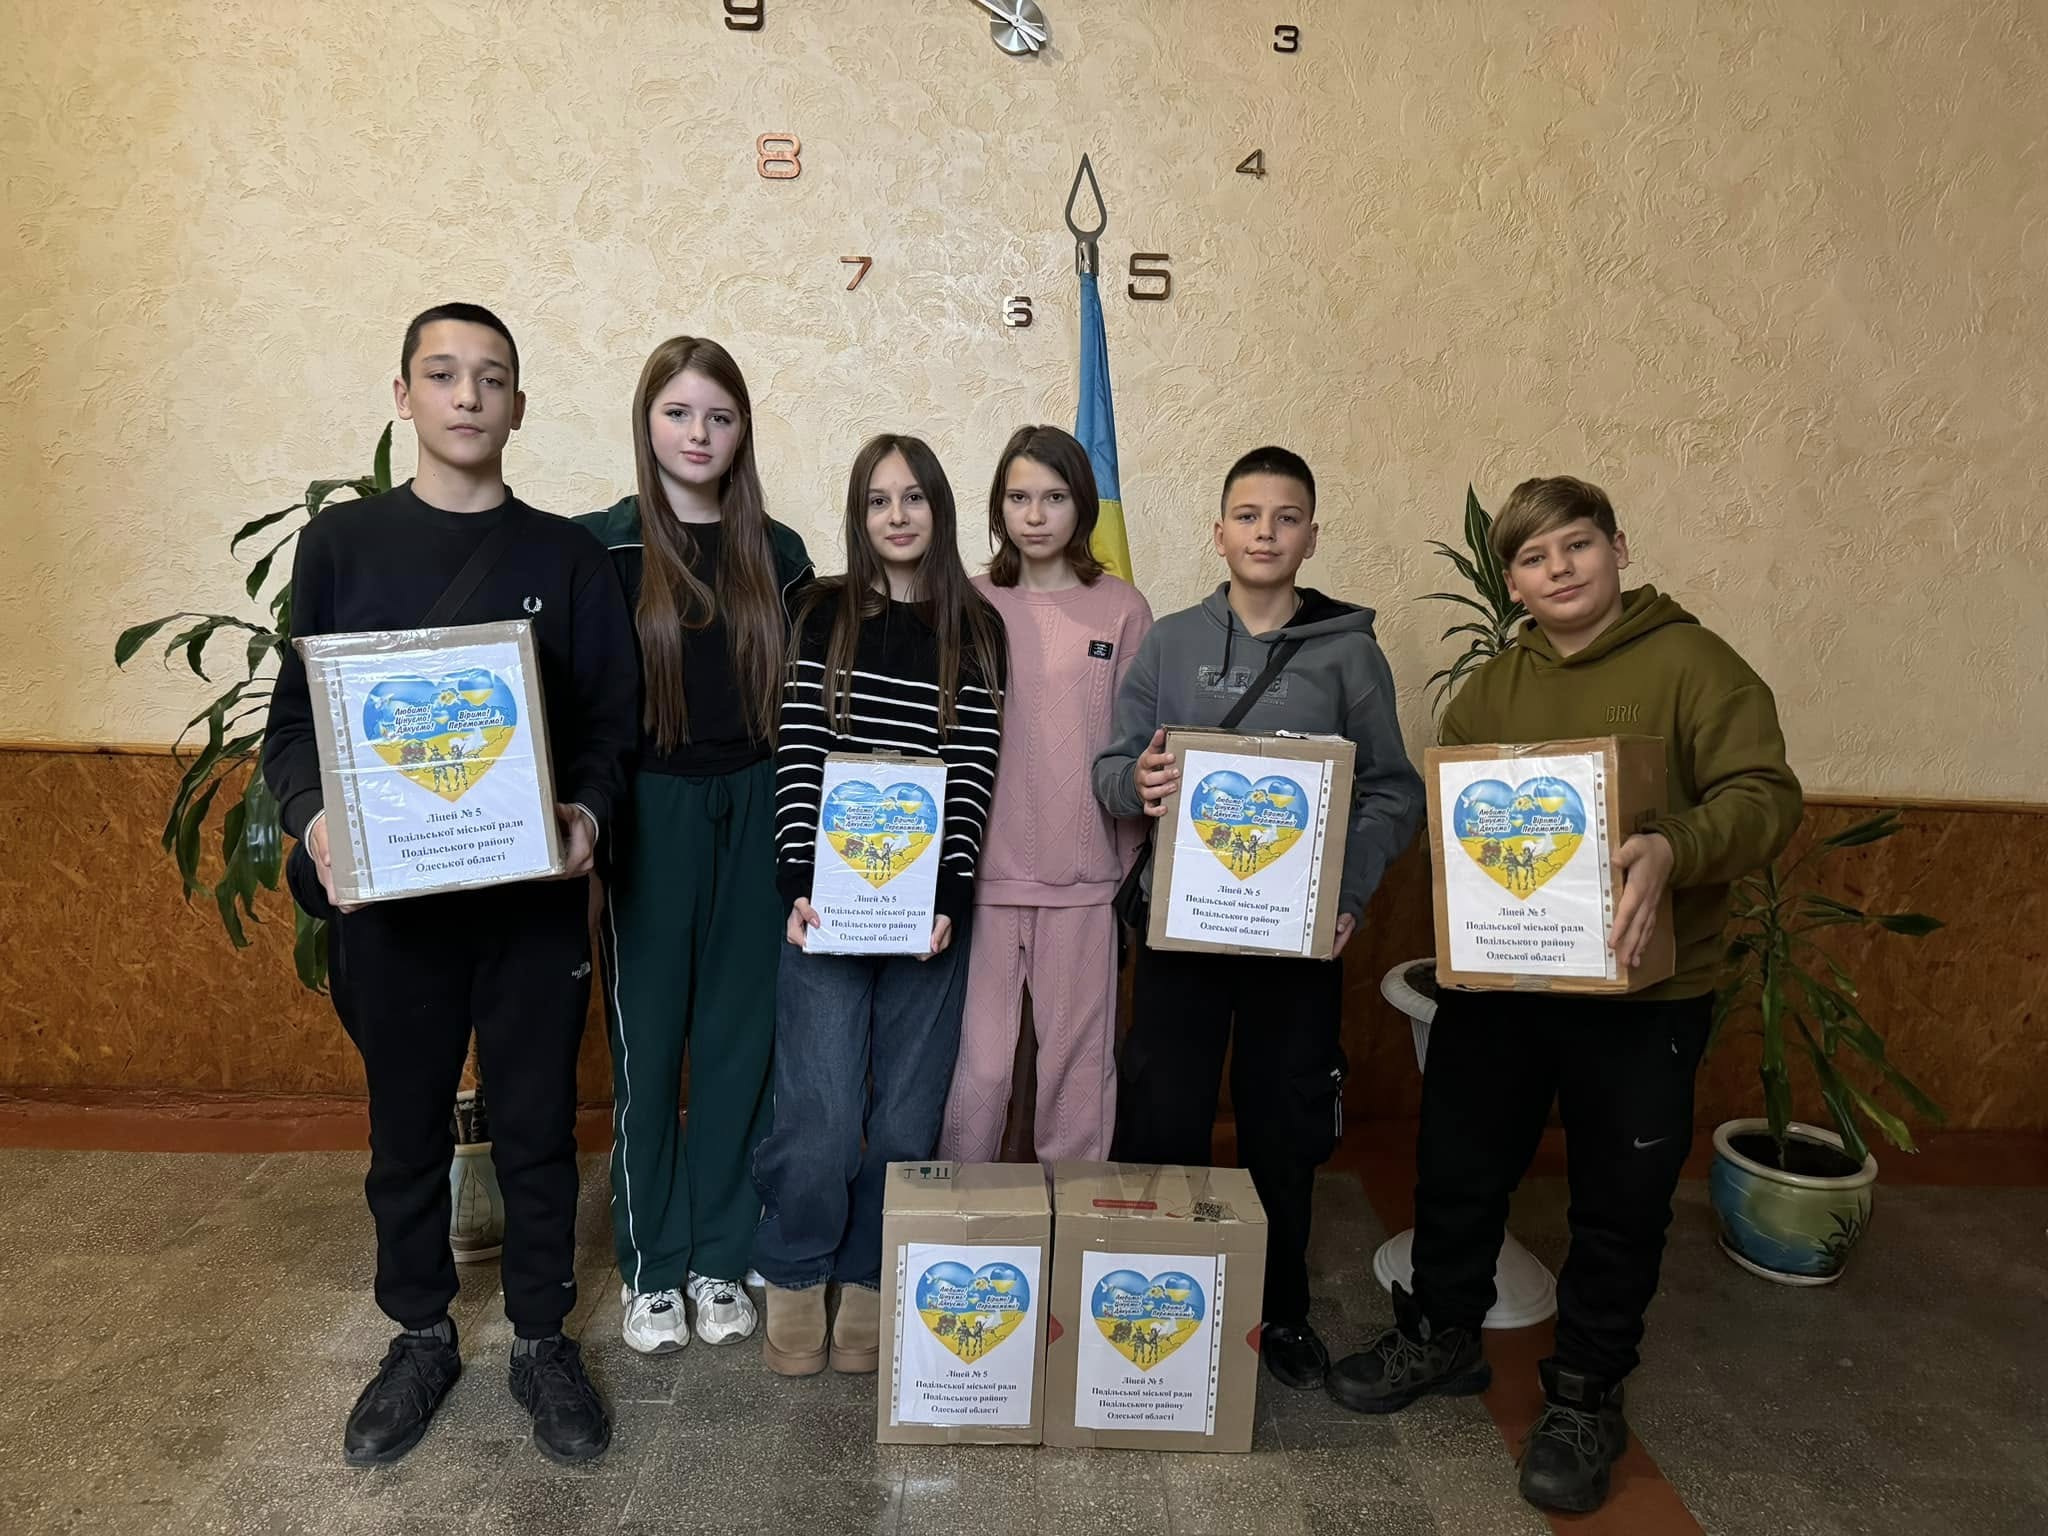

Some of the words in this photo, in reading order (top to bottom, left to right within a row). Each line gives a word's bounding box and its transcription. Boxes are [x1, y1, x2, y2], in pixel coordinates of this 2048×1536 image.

[723, 0, 764, 31] 9
[1273, 24, 1300, 53] 3
[756, 132, 802, 180] 8
[1235, 148, 1266, 180] 4
[840, 256, 873, 292] 7
[1127, 252, 1171, 301] 5
[1002, 296, 1033, 328] 6
[395, 704, 432, 716] Любимо!
[459, 709, 490, 719] Віримо!
[1606, 704, 1639, 722] BRK
[395, 715, 431, 725] Цінуємо!
[449, 717, 504, 730] Переможемо!
[396, 723, 434, 734] Дякуємо!
[426, 812, 457, 824] Ліцей
[460, 810, 474, 819] №
[476, 808, 482, 816] 5
[388, 828, 454, 844] Подільської
[456, 822, 496, 835] міської
[499, 819, 523, 833] ради
[401, 842, 474, 859] Подільського
[478, 836, 515, 852] району
[416, 858, 464, 872] Одеської
[467, 852, 506, 866] області
[1217, 885, 1242, 895] Ліцей
[1244, 888, 1254, 896] №
[854, 895, 878, 903] Ліцей
[1186, 894, 1236, 907] Подільської
[1238, 900, 1269, 910] міської
[1270, 903, 1289, 913] ради
[824, 906, 873, 916] Подільської
[875, 908, 905, 916] міської
[907, 909, 926, 917] ради
[1192, 908, 1249, 921] Подільського
[1251, 915, 1280, 925] району
[1498, 907, 1526, 917] Ліцей
[1528, 908, 1540, 917] №
[1541, 908, 1546, 916] 5
[832, 920, 887, 929] Подільського
[889, 922, 917, 930] району
[1200, 923, 1238, 933] Одеської
[1239, 927, 1270, 936] області
[1466, 921, 1521, 932] Подільської
[1524, 922, 1559, 932] міської
[1561, 924, 1584, 933] ради
[840, 933, 876, 941] Одеської
[878, 934, 908, 942] області
[1476, 936, 1538, 946] Подільського
[1541, 938, 1575, 948] району
[1487, 951, 1528, 961] Одеської
[1531, 953, 1566, 962] області
[946, 1370, 969, 1378] Ліцей
[916, 1381, 964, 1390] Подільської
[1122, 1377, 1145, 1385] Ліцей
[923, 1392, 978, 1401] Подільського
[980, 1395, 1007, 1403] району
[1092, 1388, 1140, 1397] Подільської
[1142, 1389, 1172, 1397] міської
[1099, 1400, 1153, 1409] Подільського
[1155, 1402, 1183, 1410] району
[1108, 1413, 1143, 1421] Одеської
